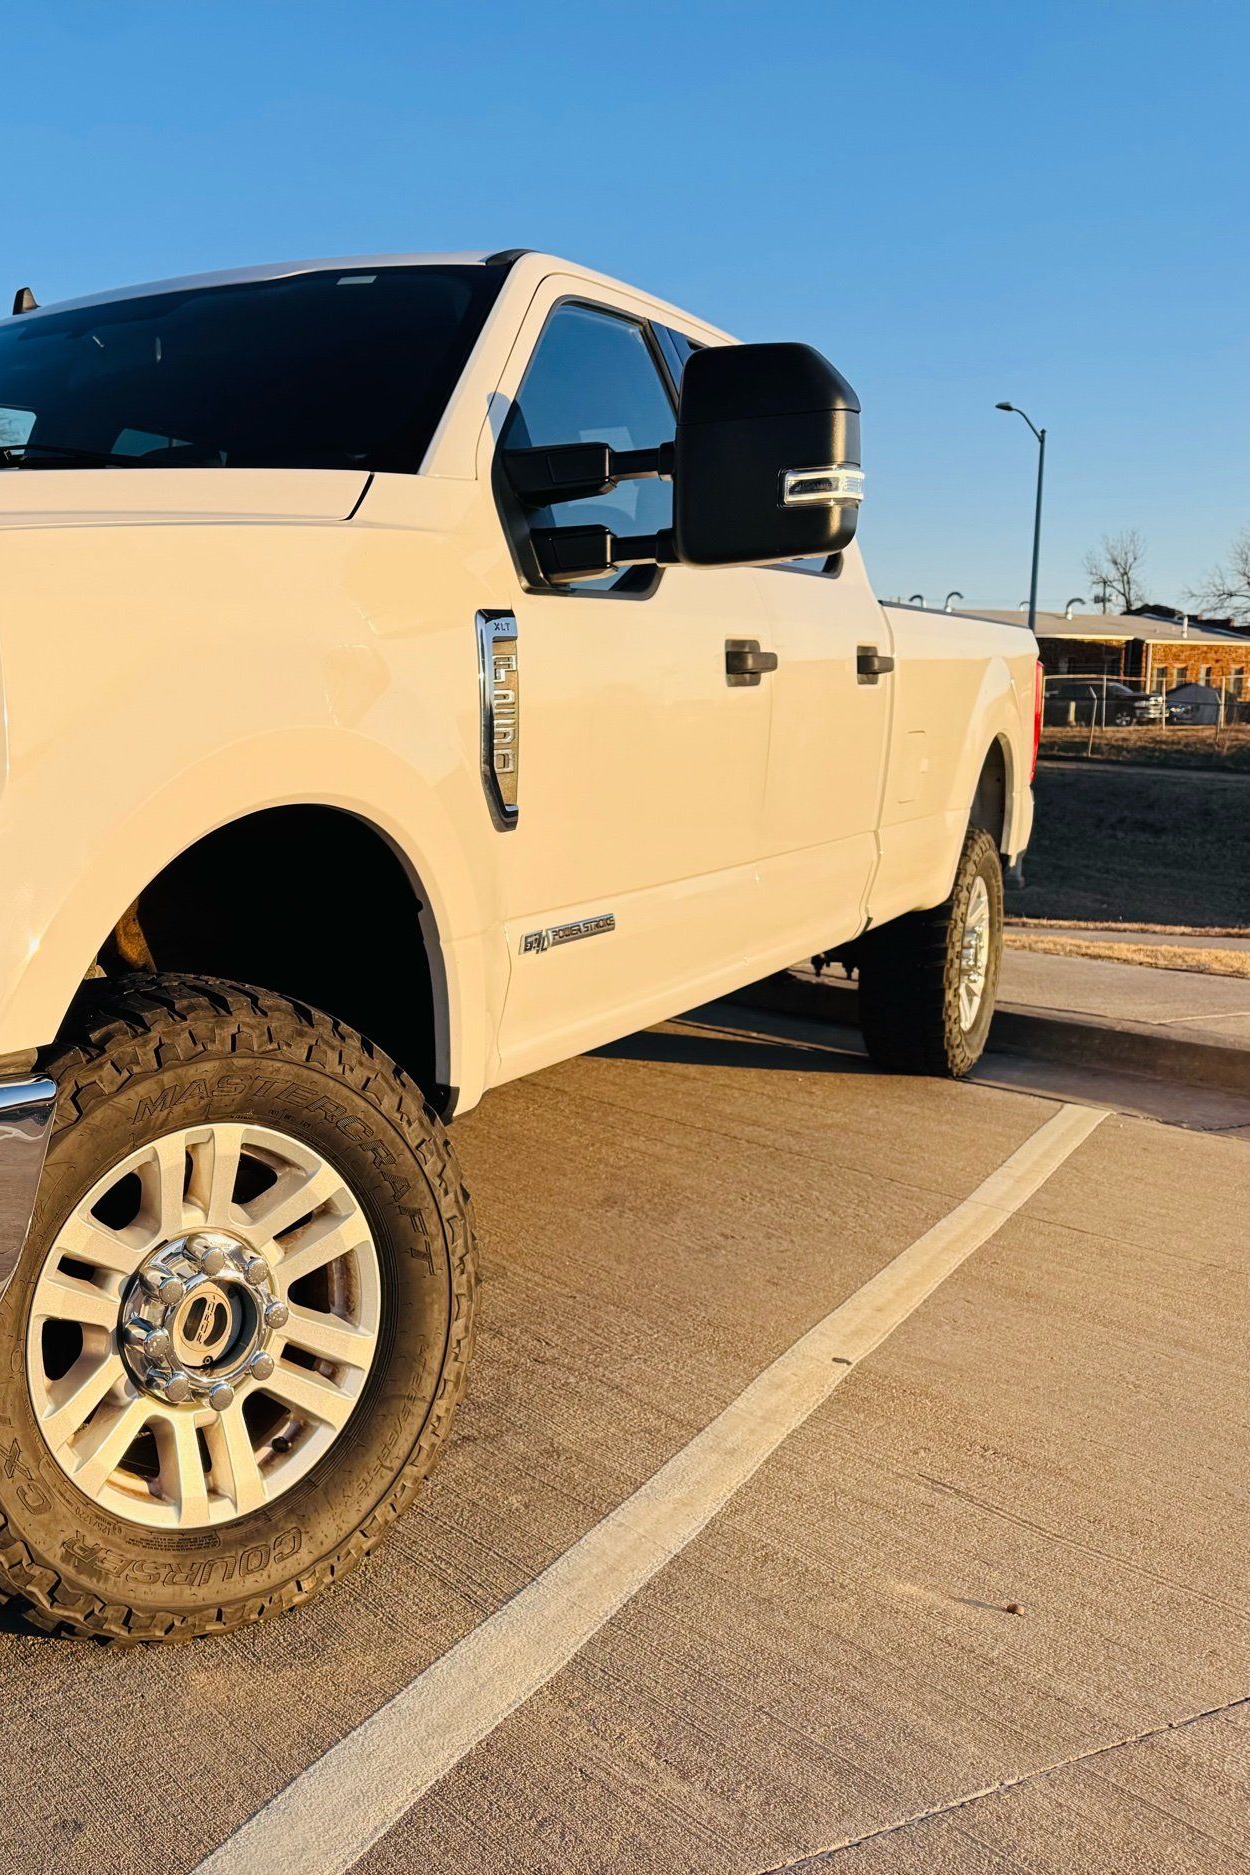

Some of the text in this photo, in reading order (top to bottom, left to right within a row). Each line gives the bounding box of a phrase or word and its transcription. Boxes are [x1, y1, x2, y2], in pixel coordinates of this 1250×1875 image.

[493, 622, 511, 631] XLT
[552, 923, 582, 941] POWER
[583, 916, 615, 933] STROKE
[131, 1073, 437, 1277] MASTERCRAFT
[61, 1526, 302, 1587] COURSER
